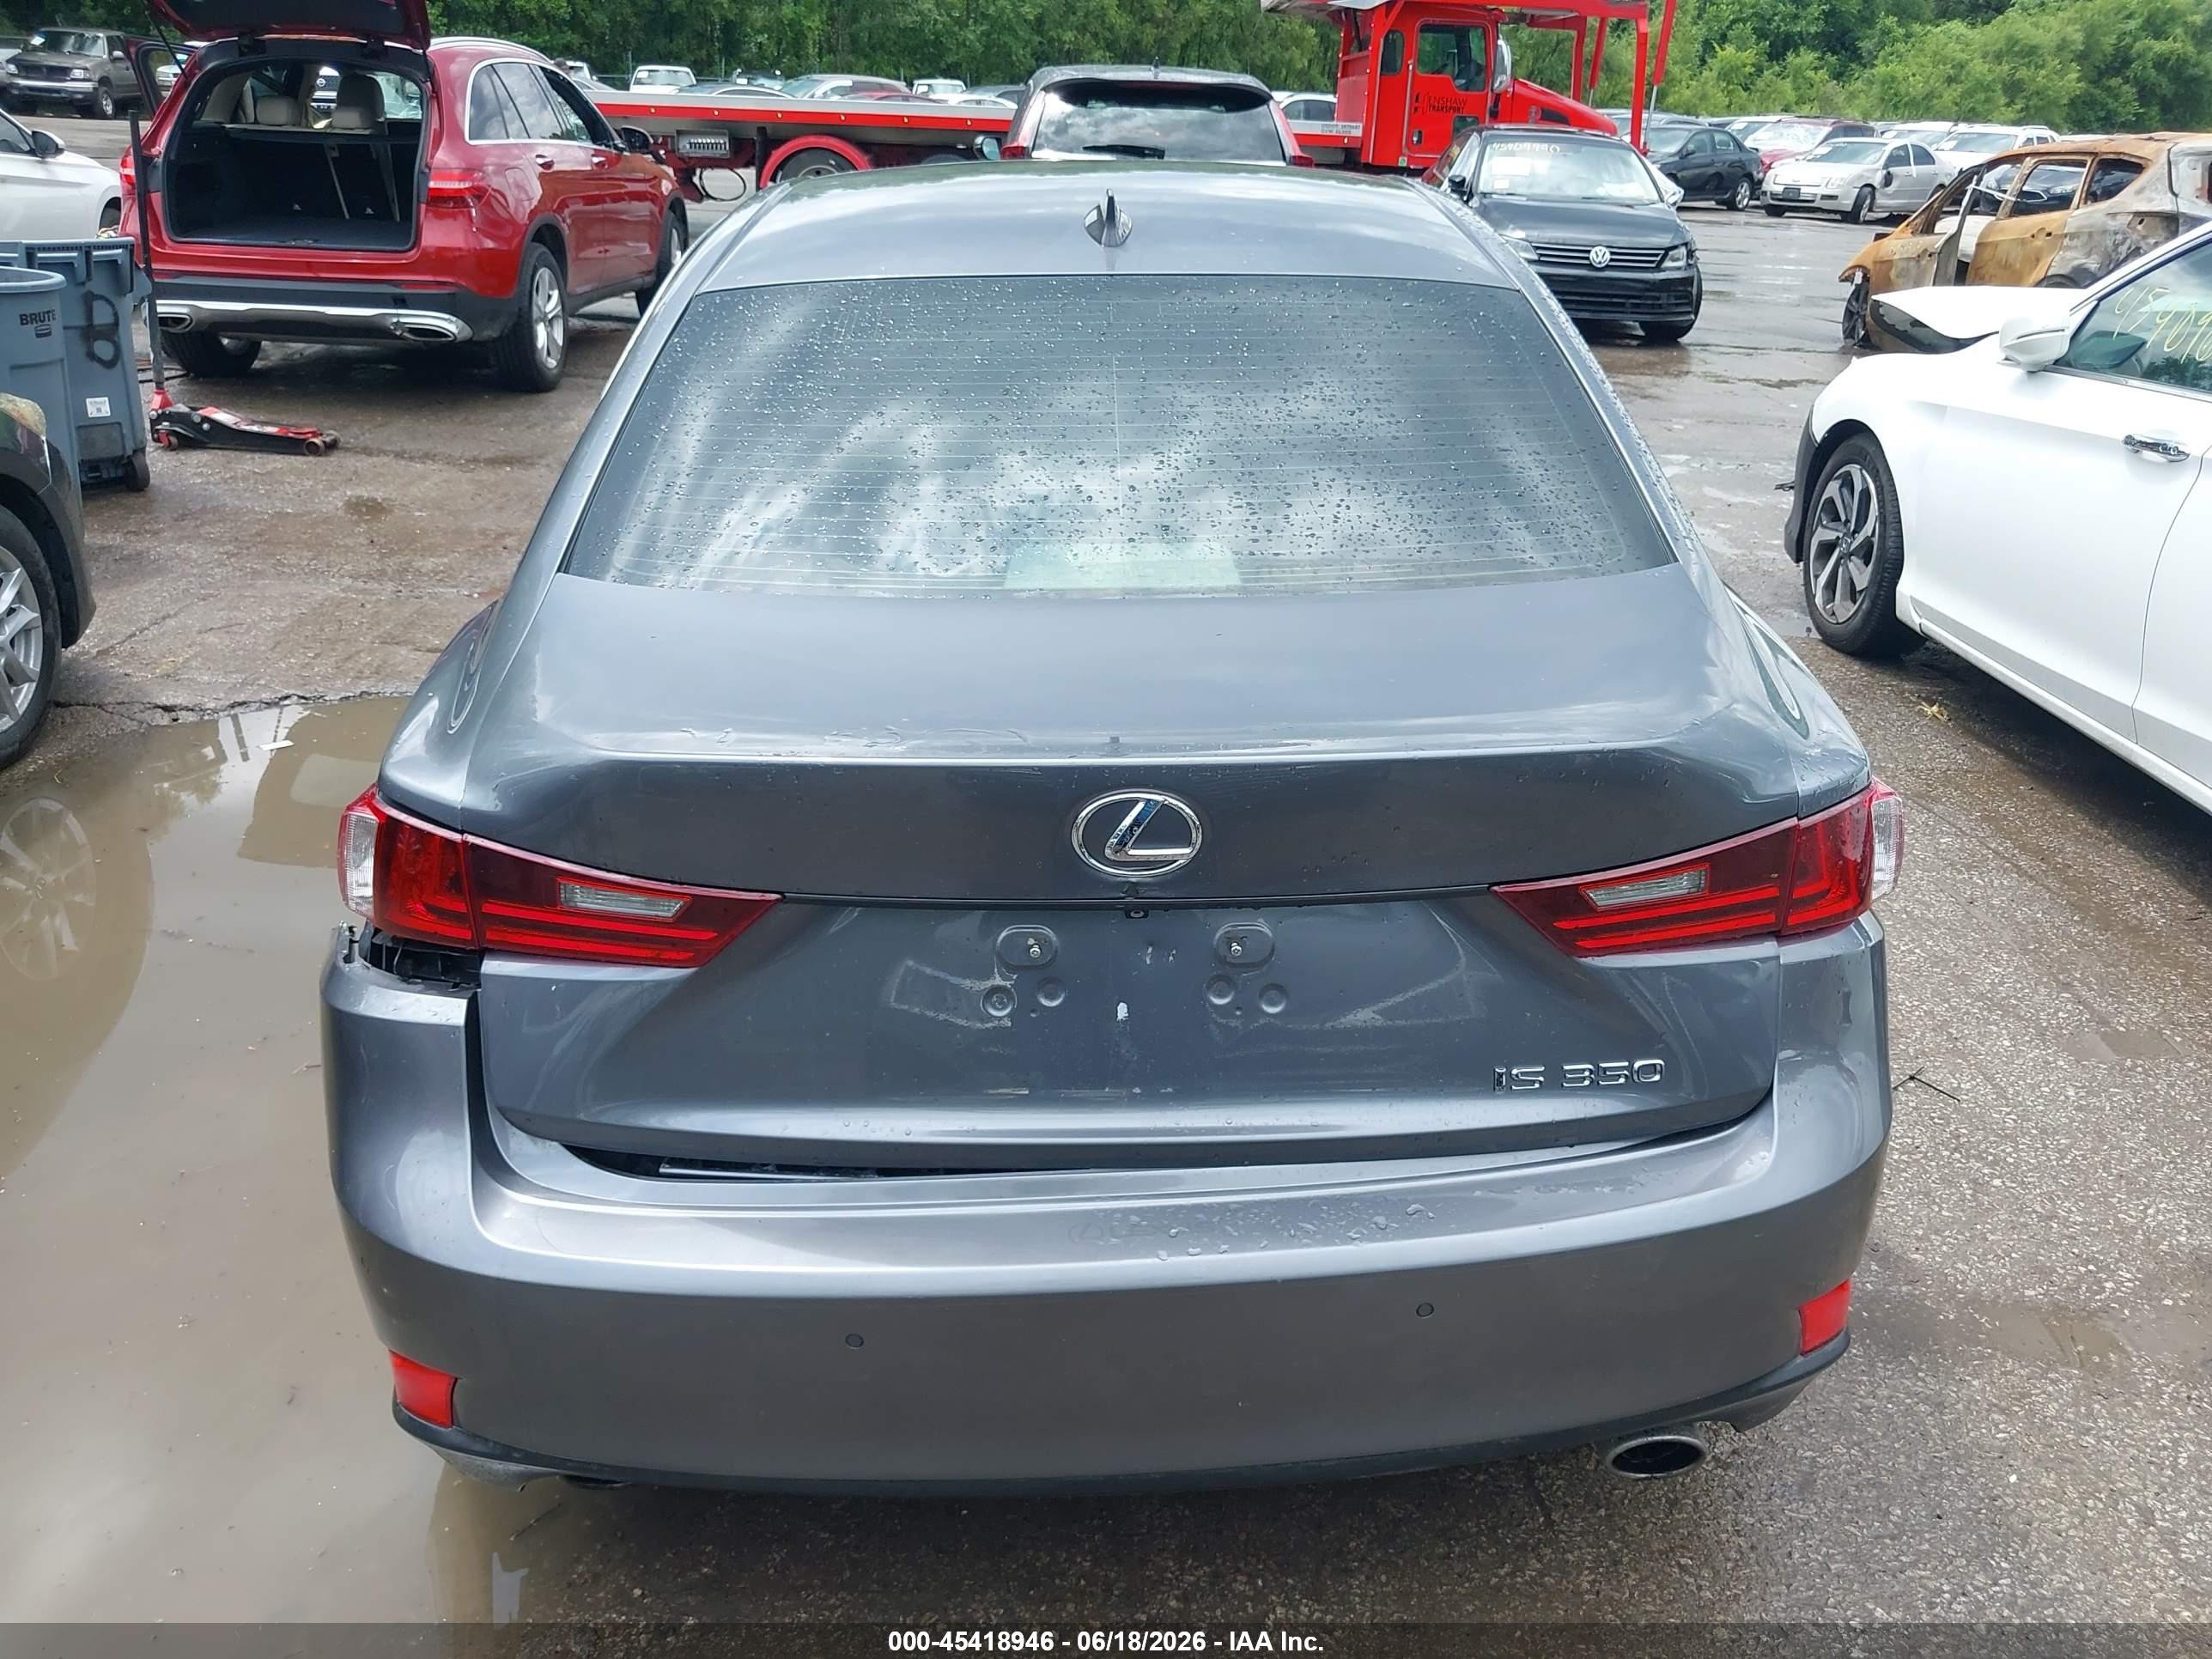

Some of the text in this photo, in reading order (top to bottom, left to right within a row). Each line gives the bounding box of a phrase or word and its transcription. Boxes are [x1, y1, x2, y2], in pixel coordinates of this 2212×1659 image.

[1428, 105, 1464, 114] TRANSPORT
[19, 309, 57, 326] BRUTE
[1493, 1059, 1665, 1092] IS 350
